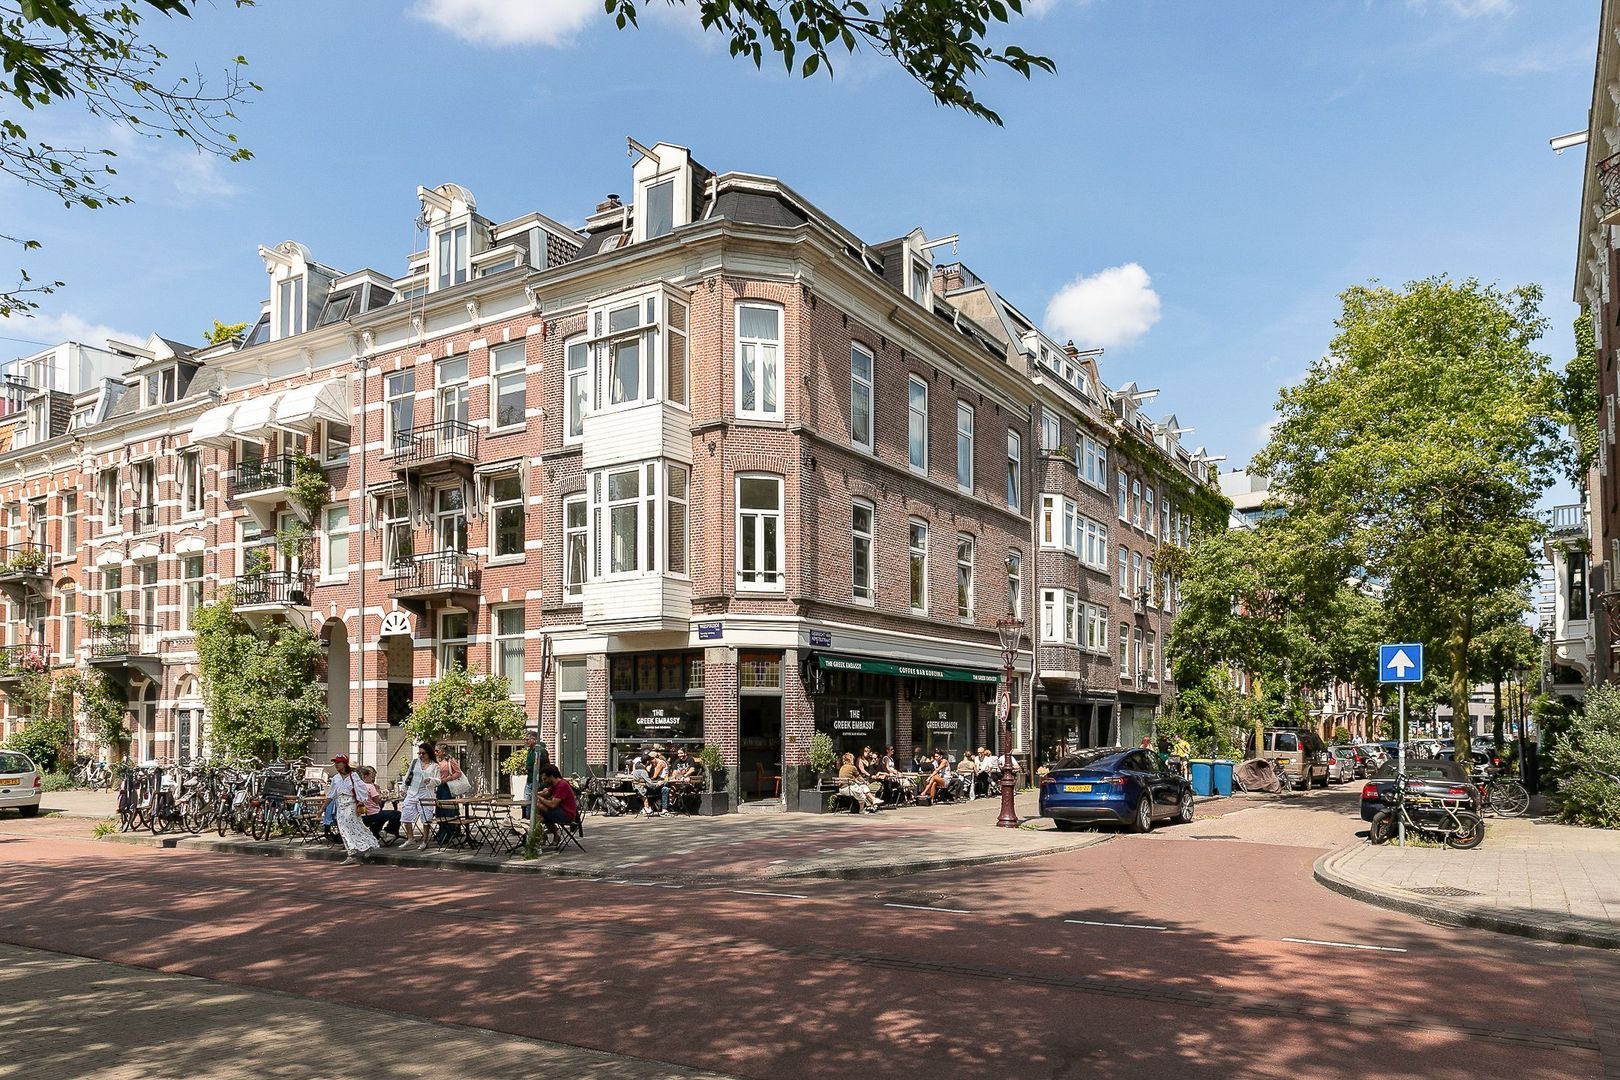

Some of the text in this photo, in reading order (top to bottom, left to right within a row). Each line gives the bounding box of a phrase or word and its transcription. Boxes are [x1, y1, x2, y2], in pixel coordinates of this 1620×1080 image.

[899, 666, 916, 674] COFFEE
[850, 710, 860, 718] THE
[938, 711, 947, 720] THE
[834, 720, 874, 730] GREEK EMBASSY
[926, 720, 958, 728] GREEK EMBASSY
